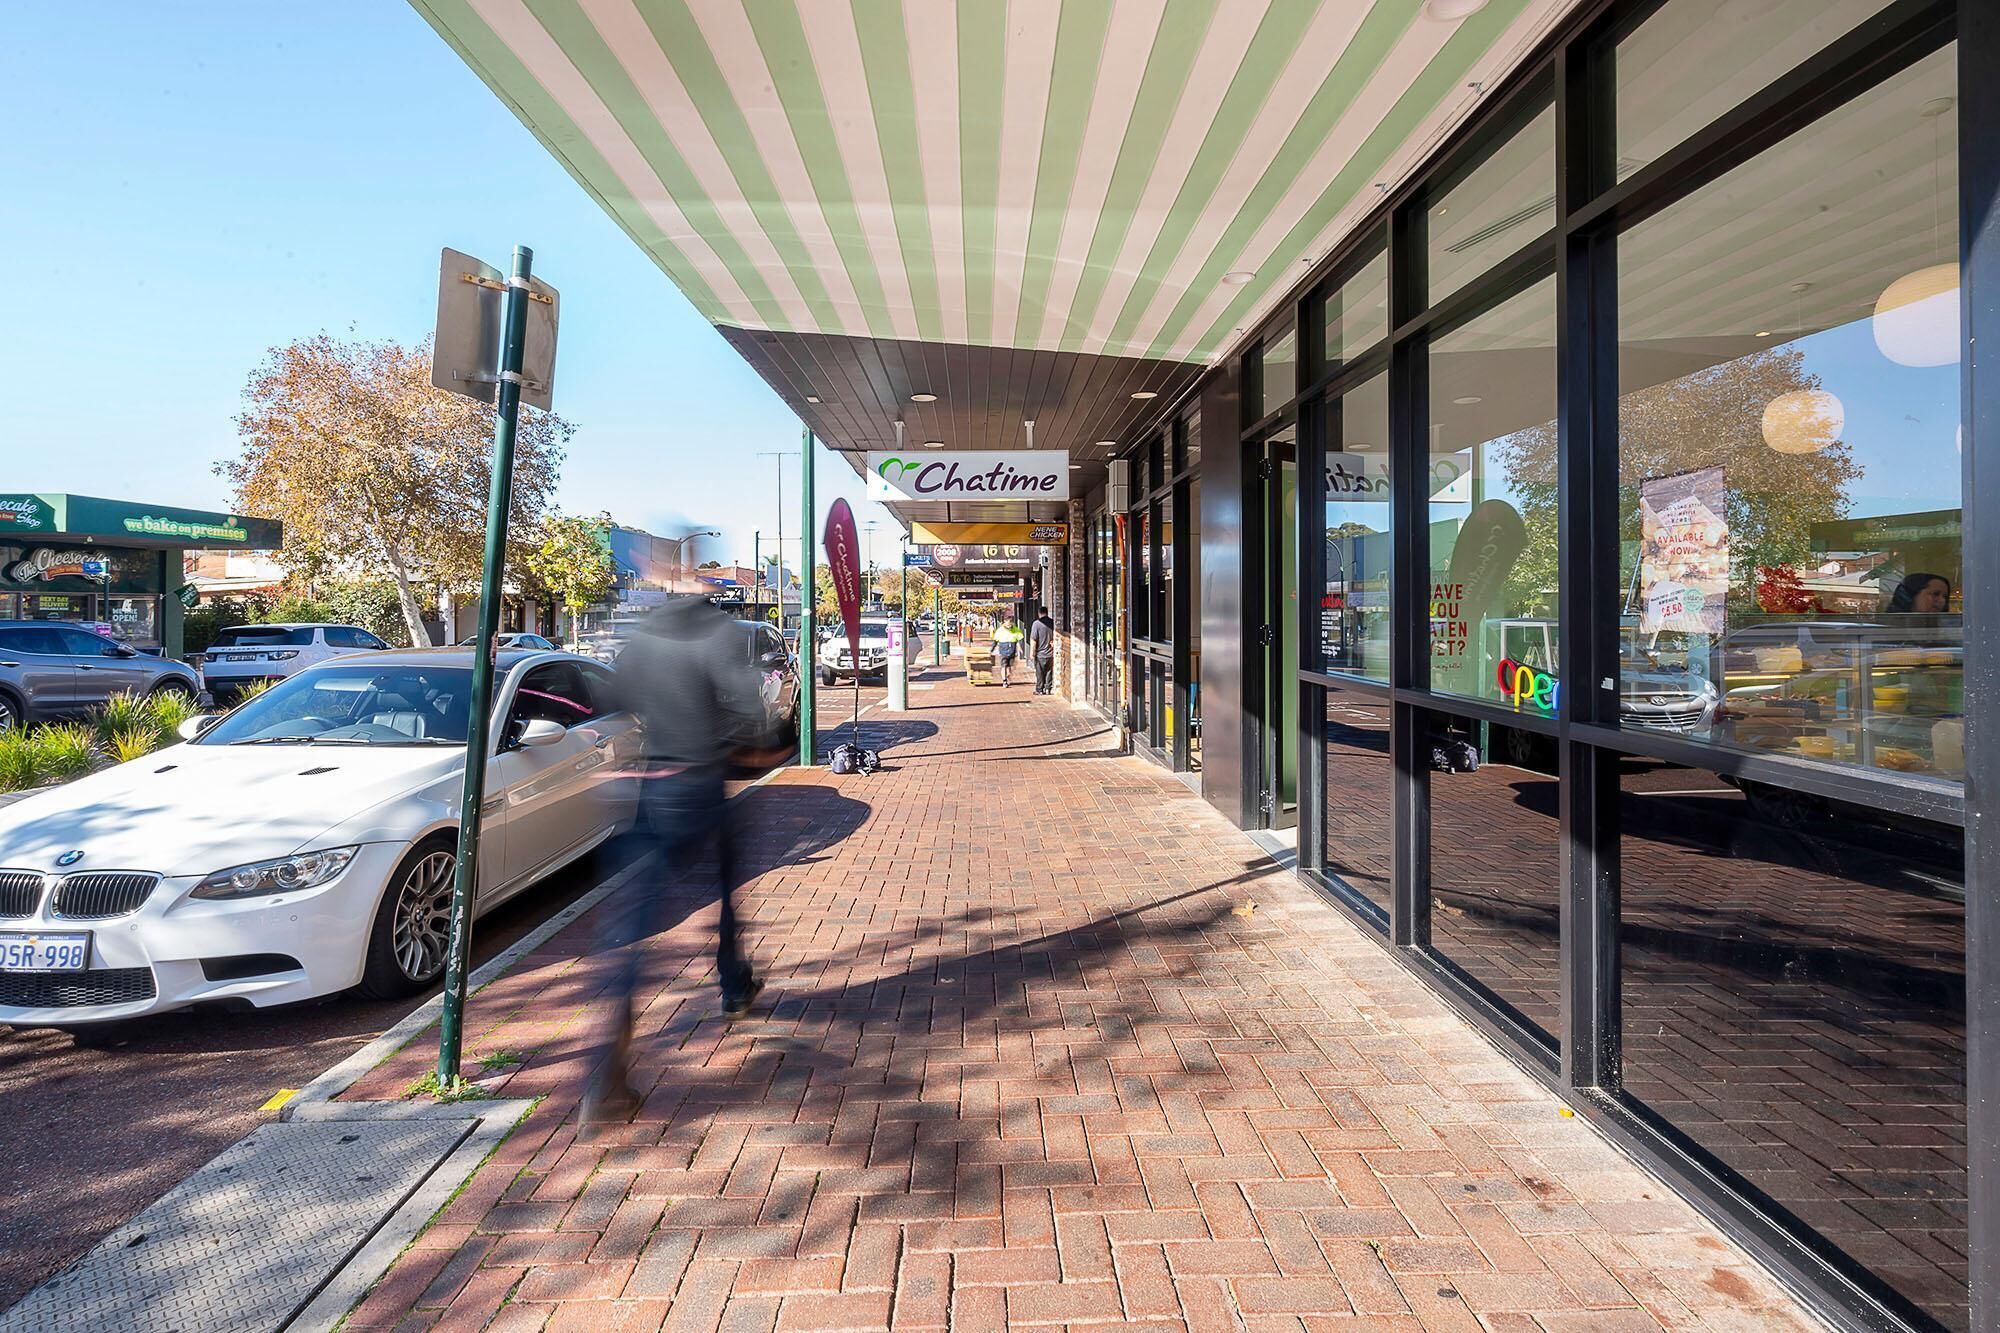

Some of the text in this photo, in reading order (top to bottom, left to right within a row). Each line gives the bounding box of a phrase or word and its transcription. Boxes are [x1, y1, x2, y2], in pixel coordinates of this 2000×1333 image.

[914, 462, 1058, 493] Chatime
[16, 512, 41, 528] Shop
[144, 519, 177, 532] bake
[178, 525, 192, 533] on
[192, 525, 244, 538] premises
[1657, 532, 1704, 544] AVAILABLE
[1669, 547, 1691, 555] NOW
[37, 549, 106, 571] Cheesecak
[20, 563, 38, 578] The
[837, 543, 856, 602] Chatime
[1430, 622, 1467, 637] ATEN
